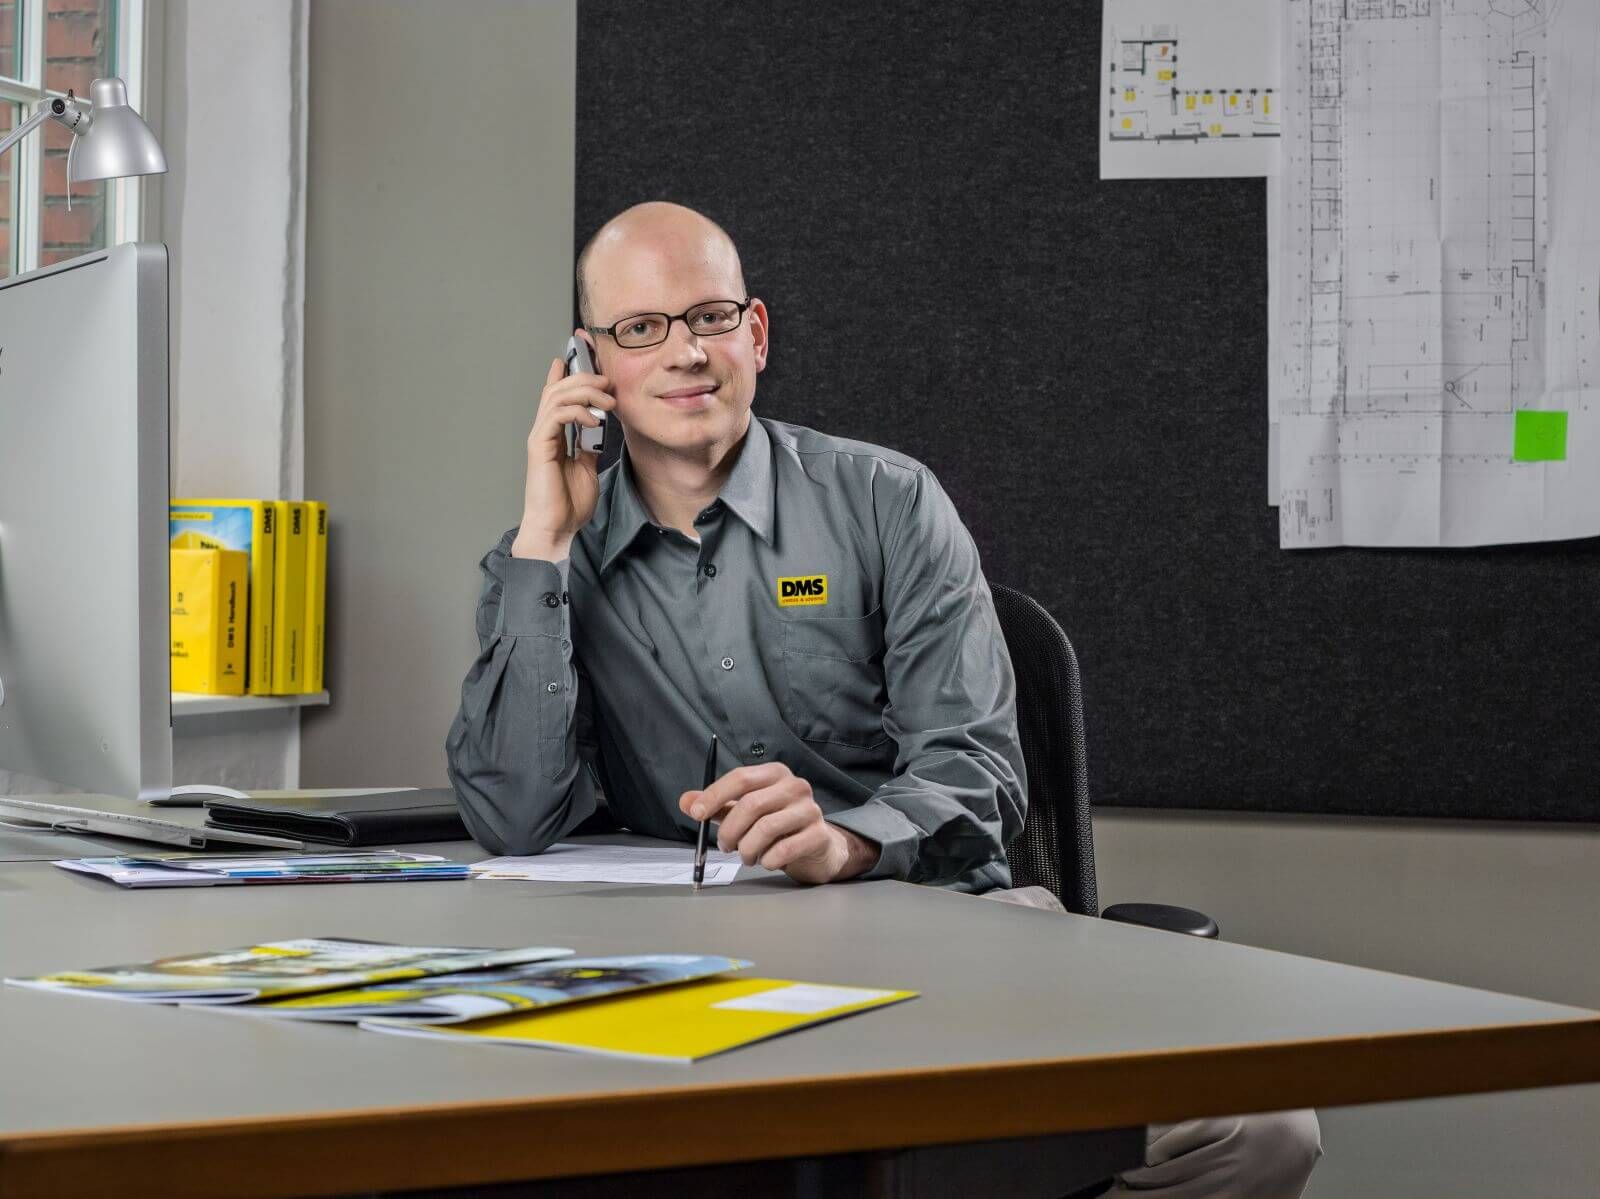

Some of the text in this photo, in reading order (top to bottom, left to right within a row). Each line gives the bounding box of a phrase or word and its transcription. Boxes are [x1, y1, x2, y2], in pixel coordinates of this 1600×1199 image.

[264, 507, 272, 534] DMS
[293, 508, 301, 535] DMS
[318, 509, 326, 535] DMS
[782, 578, 824, 597] DMS
